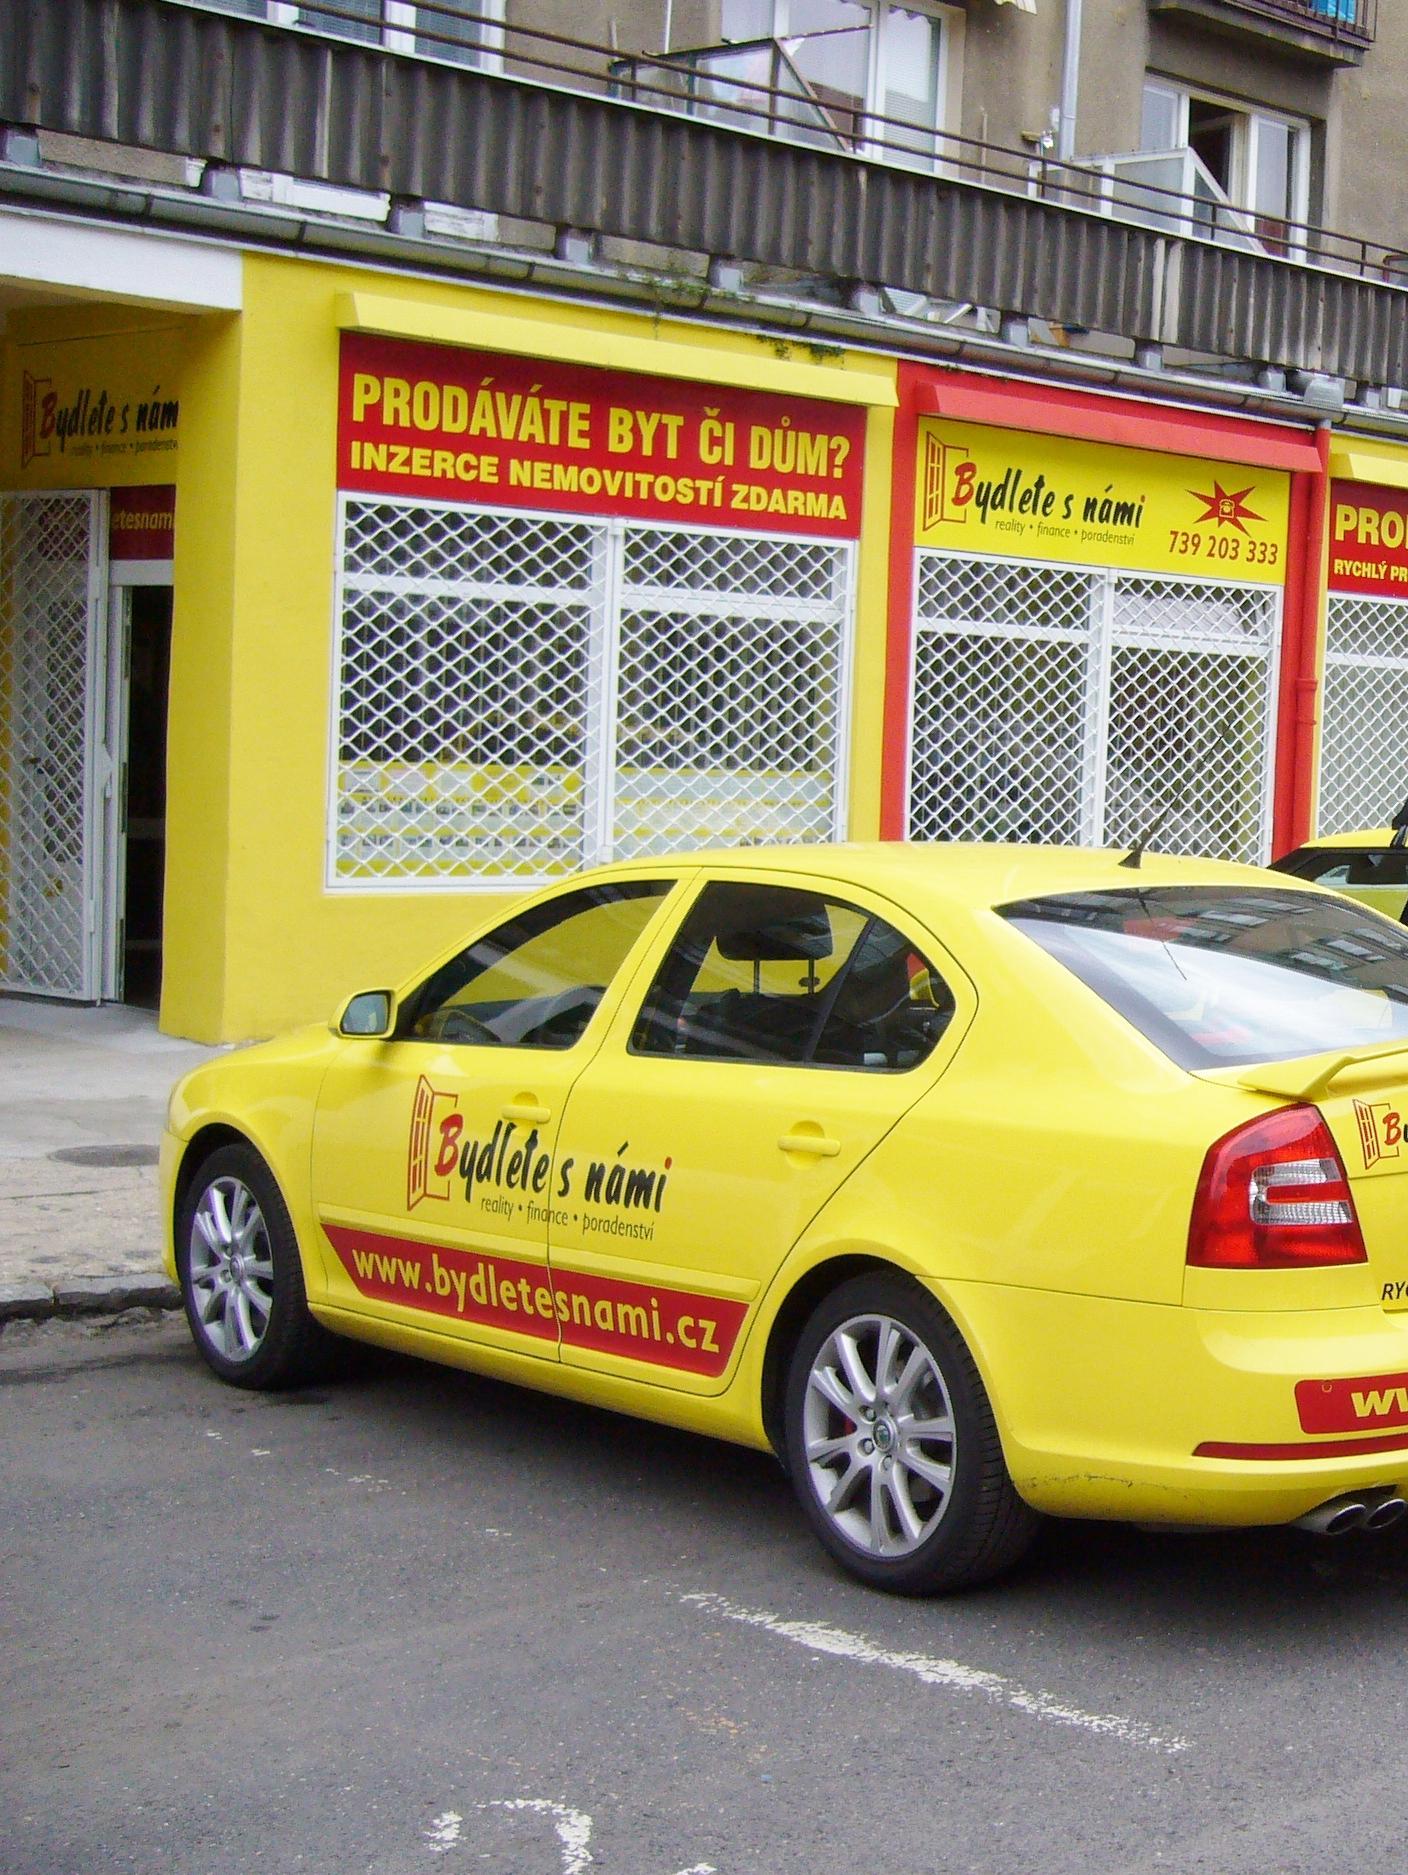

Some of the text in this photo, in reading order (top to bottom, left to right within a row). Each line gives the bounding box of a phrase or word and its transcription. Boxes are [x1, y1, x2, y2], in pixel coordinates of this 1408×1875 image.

[40, 388, 117, 453] Bydlete
[136, 384, 179, 433] nám
[352, 372, 851, 479] PRODÁVÁTE BYT ČI DŮM?
[350, 440, 848, 521] INZERCE NEMOVITOSTÍ ZDARMA
[951, 461, 1146, 529] Bydlete s námi
[994, 518, 1136, 546] reality finance poradenství
[1168, 529, 1279, 566] 739 203 333
[1333, 557, 1388, 580] RYCHLÝ
[434, 1113, 673, 1213] Bydlete s námi
[480, 1196, 656, 1242] reality finance poradenství
[351, 1248, 721, 1354] www.bydletesnami.cz
